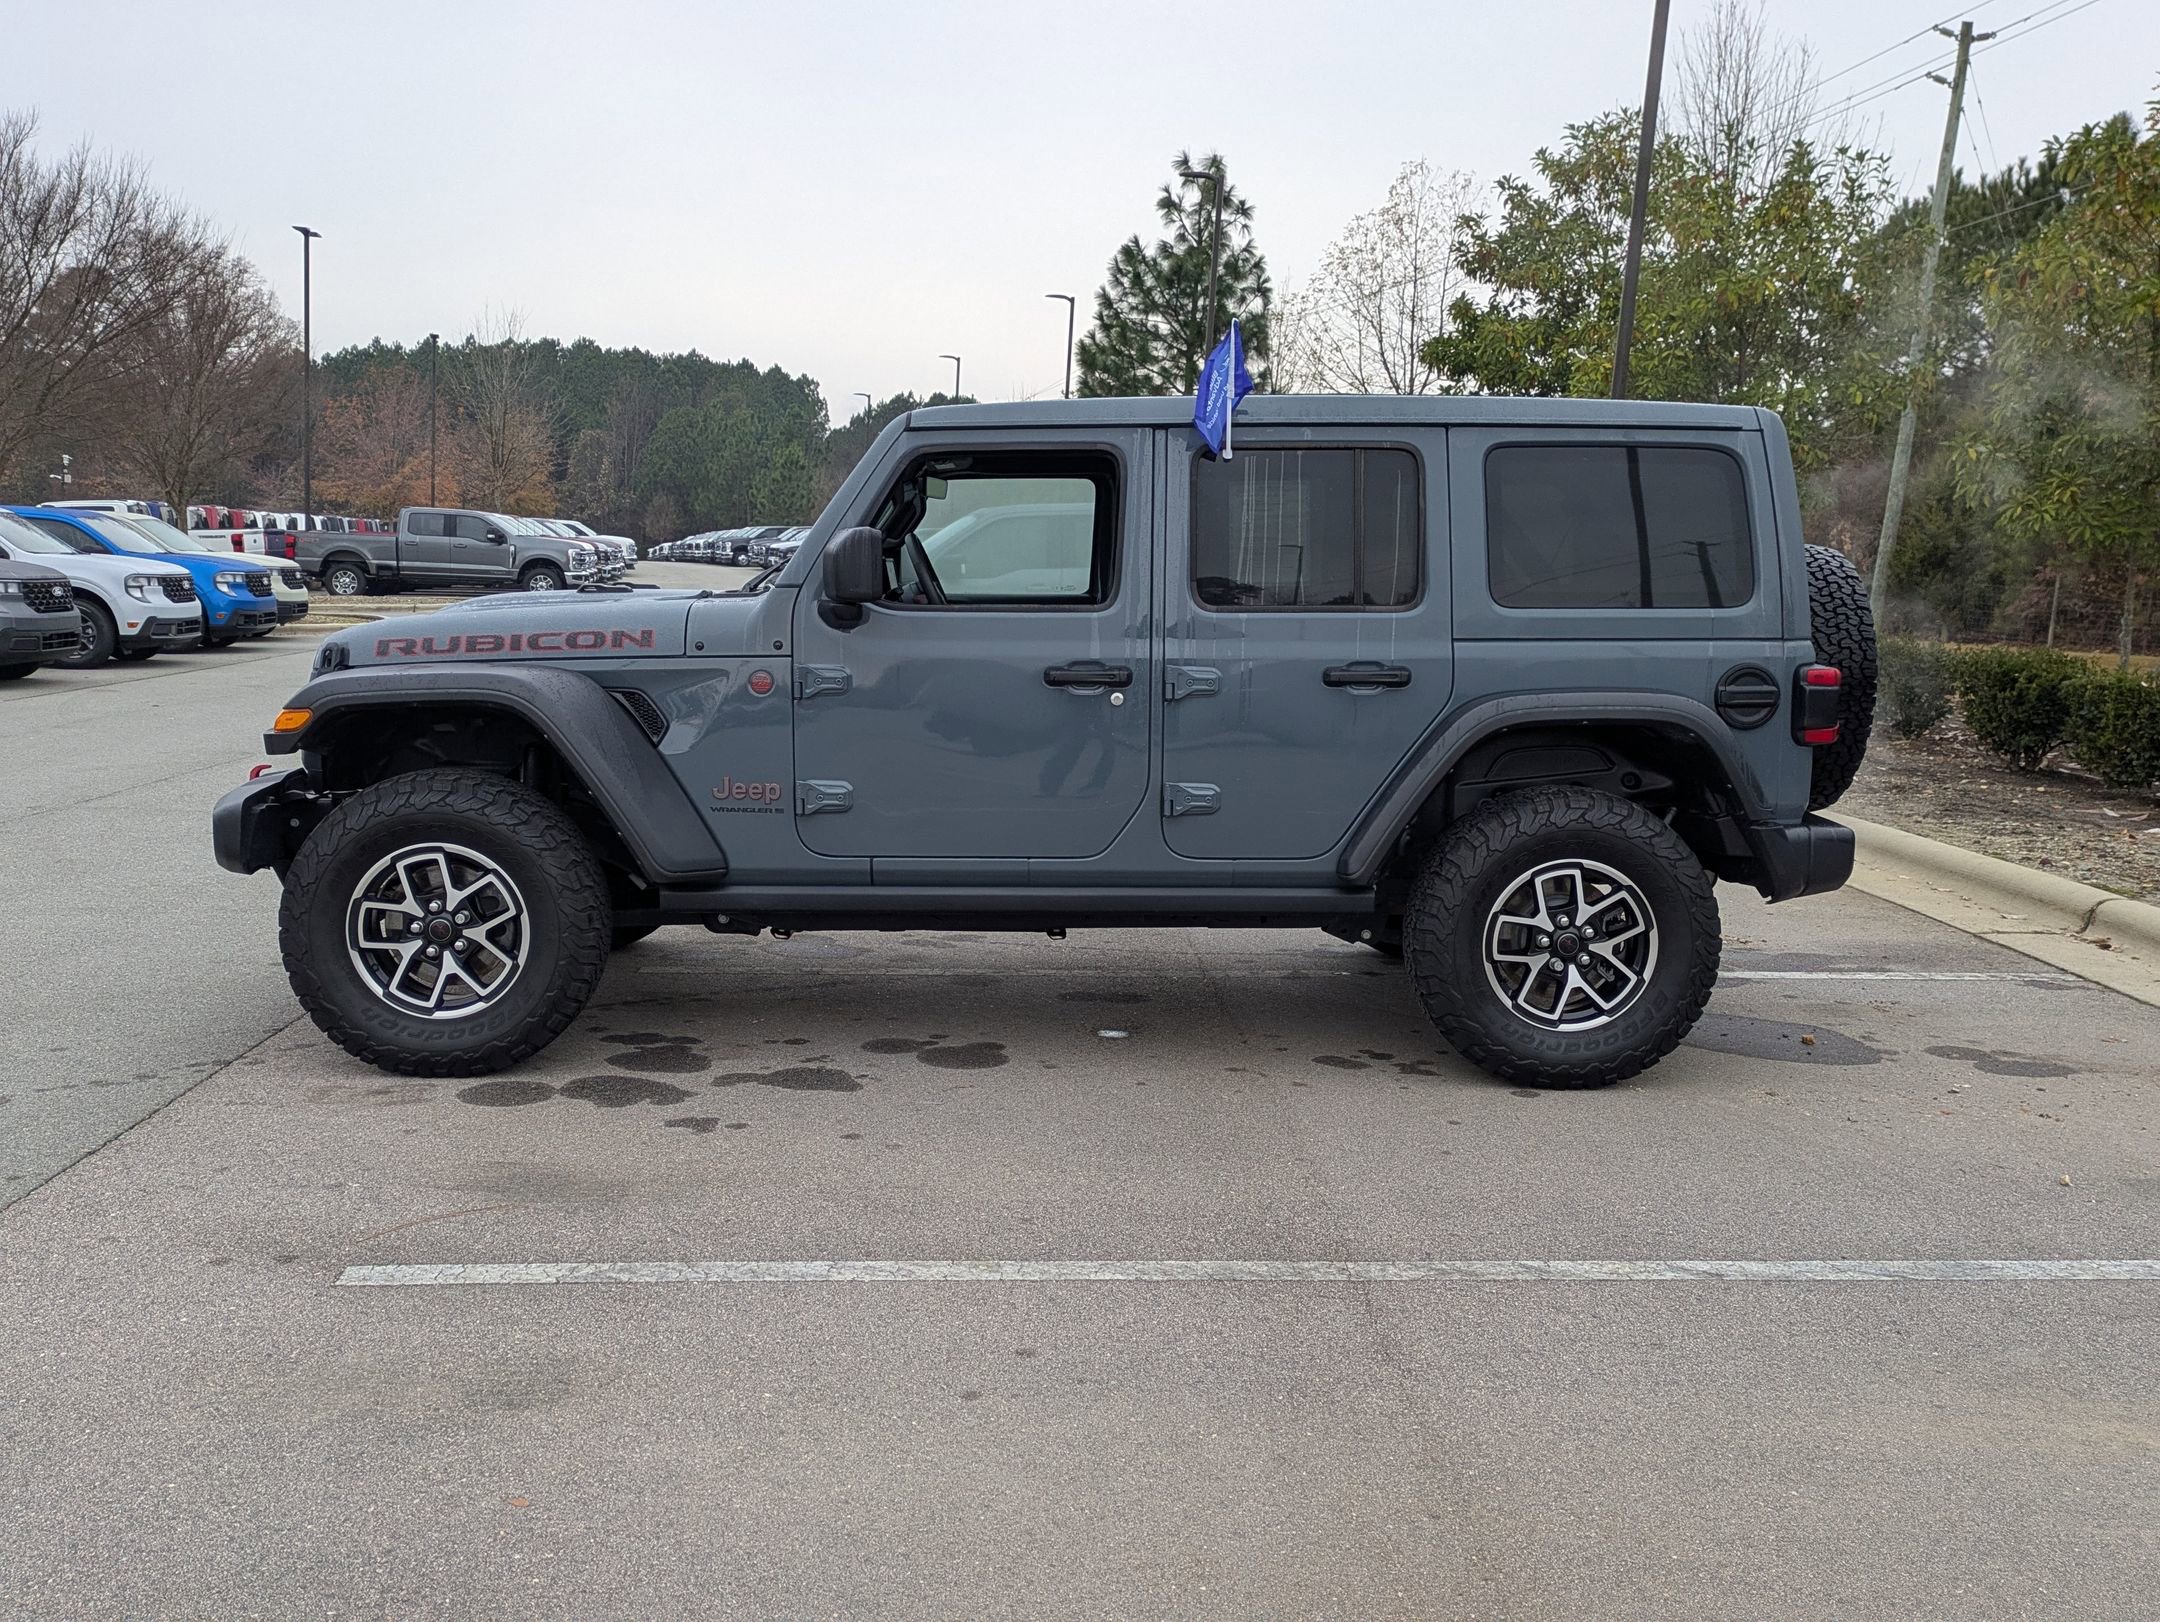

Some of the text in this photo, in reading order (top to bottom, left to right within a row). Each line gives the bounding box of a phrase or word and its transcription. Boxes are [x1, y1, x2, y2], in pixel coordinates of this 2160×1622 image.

[375, 629, 656, 657] RUBICON
[712, 775, 782, 805] Jeep
[709, 806, 773, 814] WRANGLER
